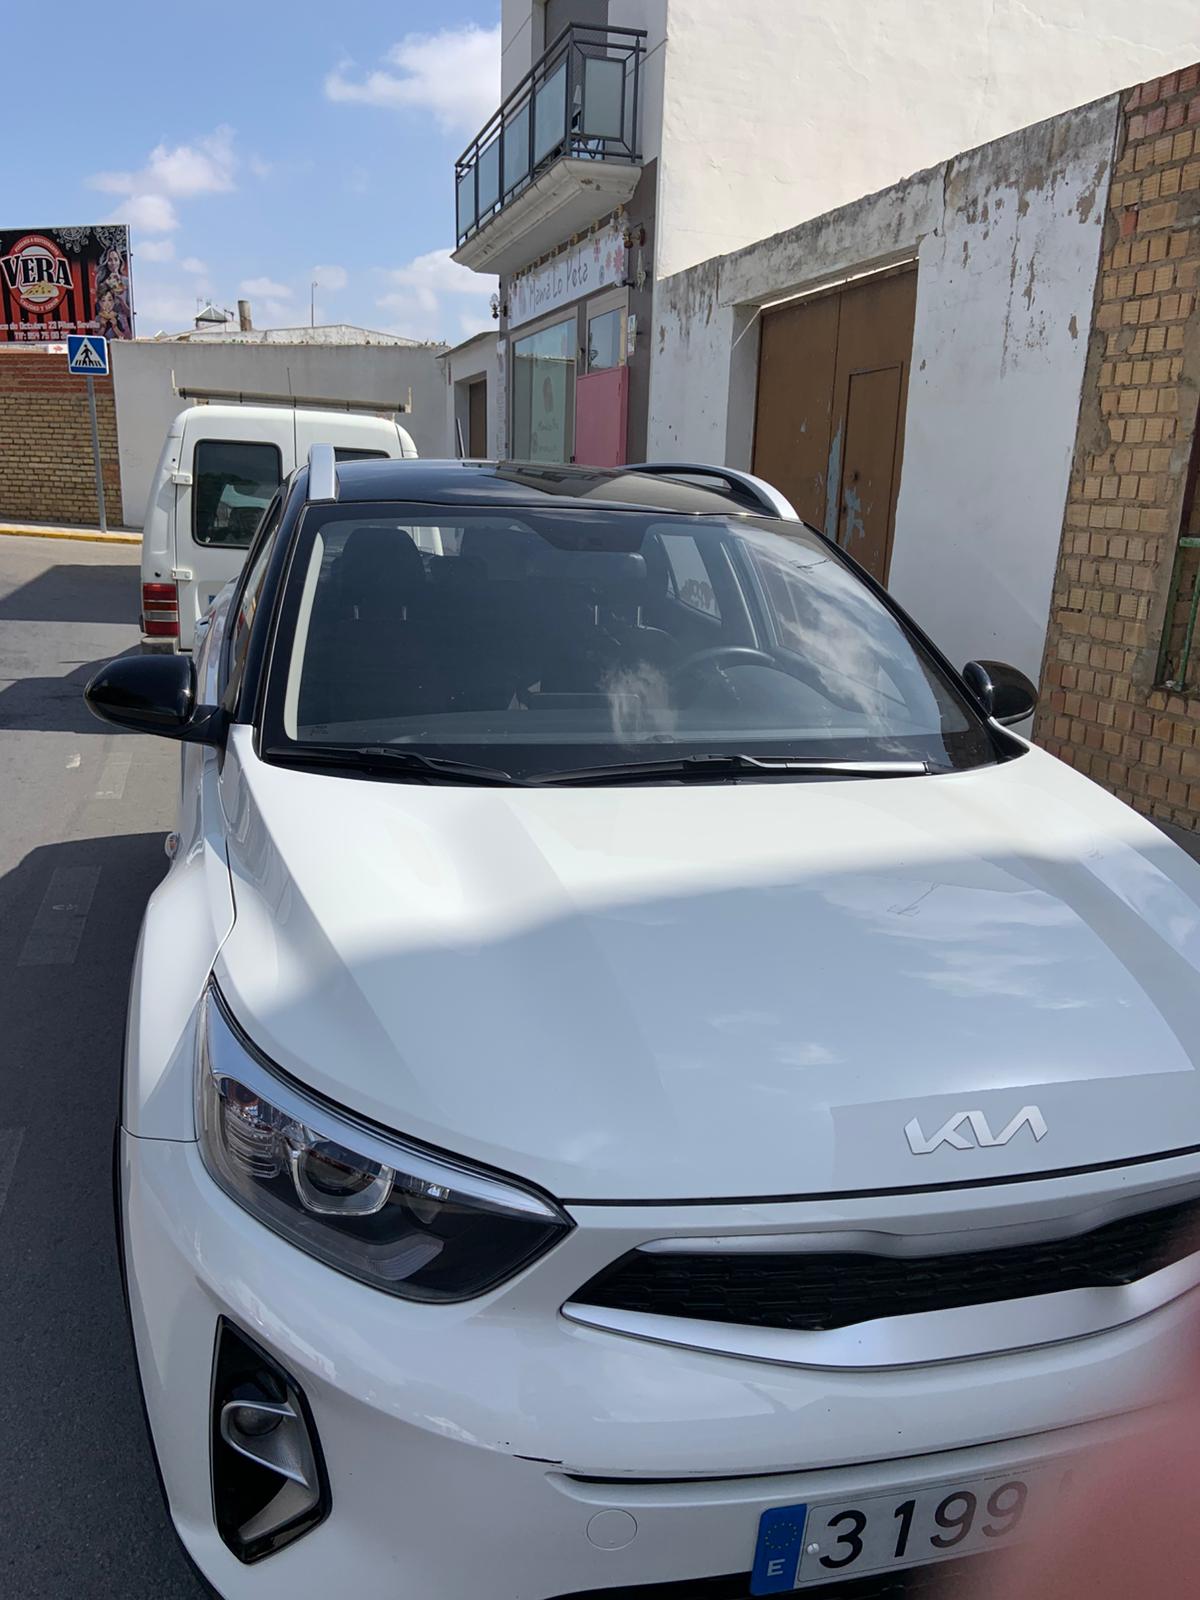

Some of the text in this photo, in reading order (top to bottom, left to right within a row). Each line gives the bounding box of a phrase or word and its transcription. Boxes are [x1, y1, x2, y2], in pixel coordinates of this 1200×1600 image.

[1, 255, 73, 288] VERA
[904, 1105, 1048, 1155] KIA
[818, 1480, 1028, 1570] 3199
[766, 1558, 785, 1577] E
